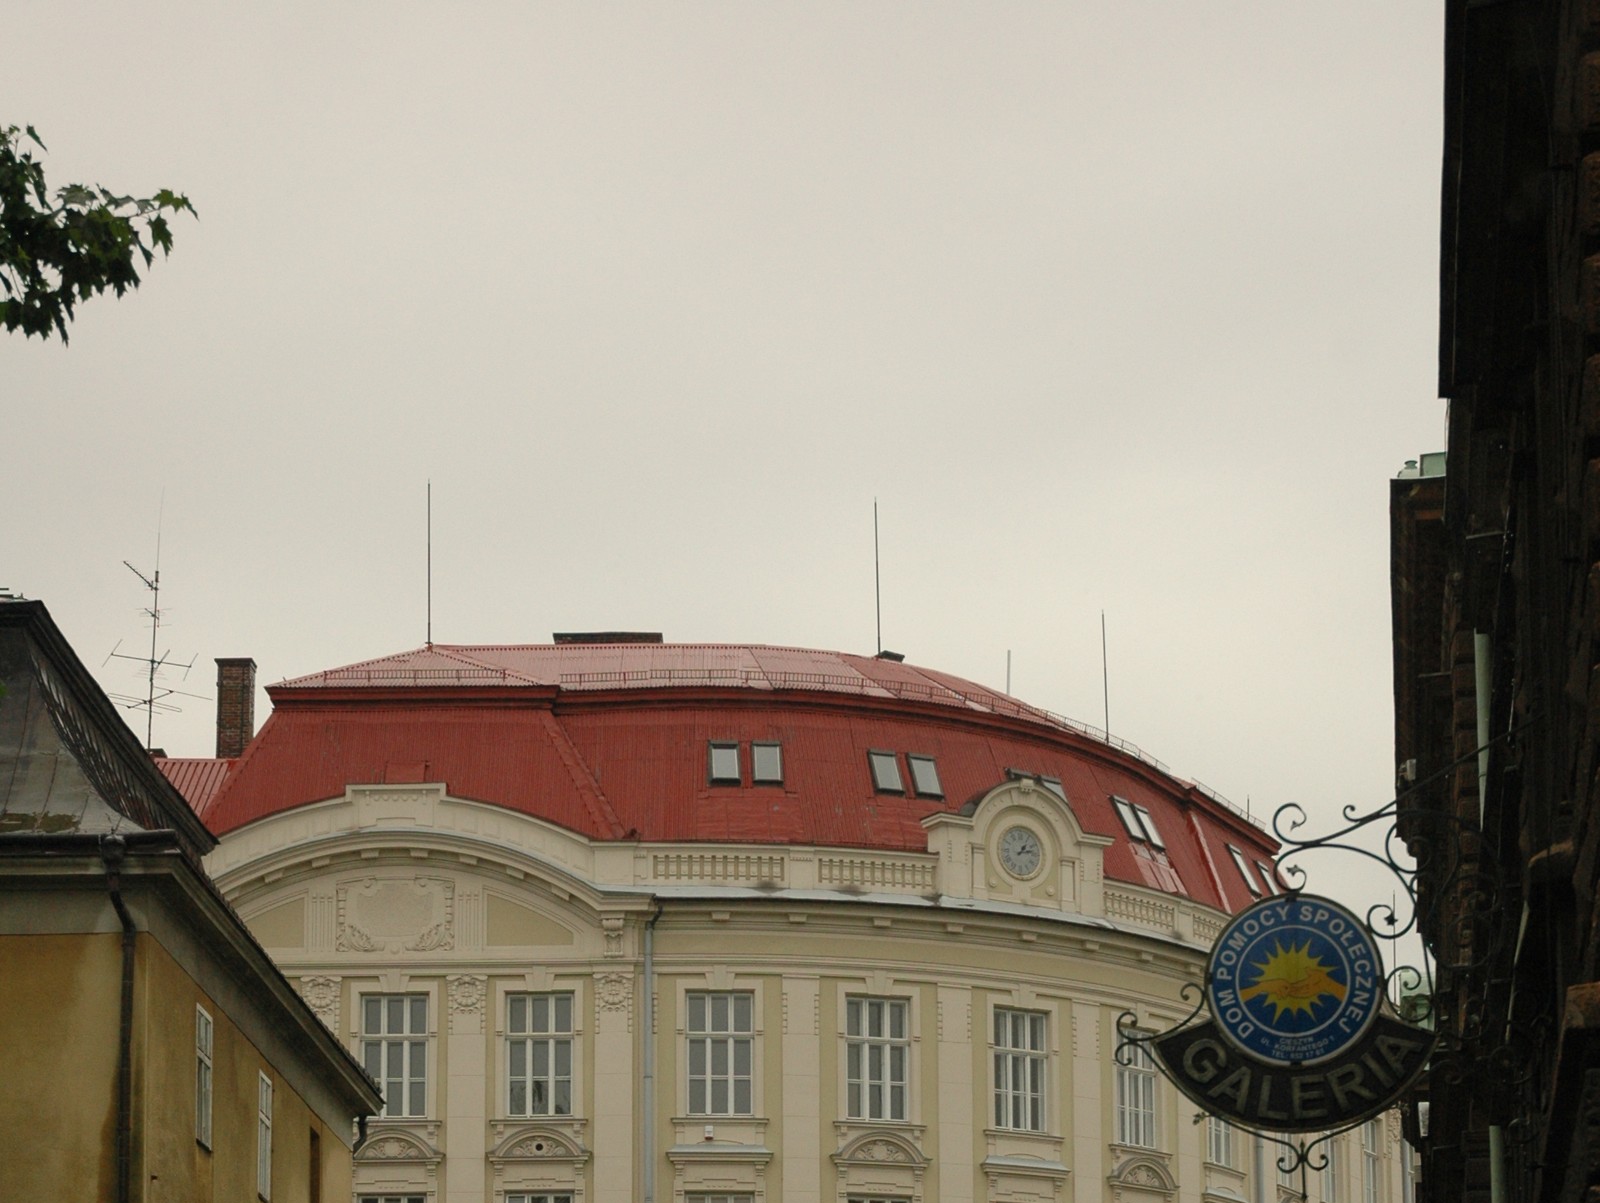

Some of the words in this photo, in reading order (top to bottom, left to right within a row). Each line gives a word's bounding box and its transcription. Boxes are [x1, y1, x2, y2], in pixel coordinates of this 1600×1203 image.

[1216, 905, 1291, 982] POMOCY
[1300, 905, 1373, 1034] SPOŁECZNEJ
[1216, 989, 1255, 1040] DOM
[1183, 1033, 1425, 1121] GALERIA
